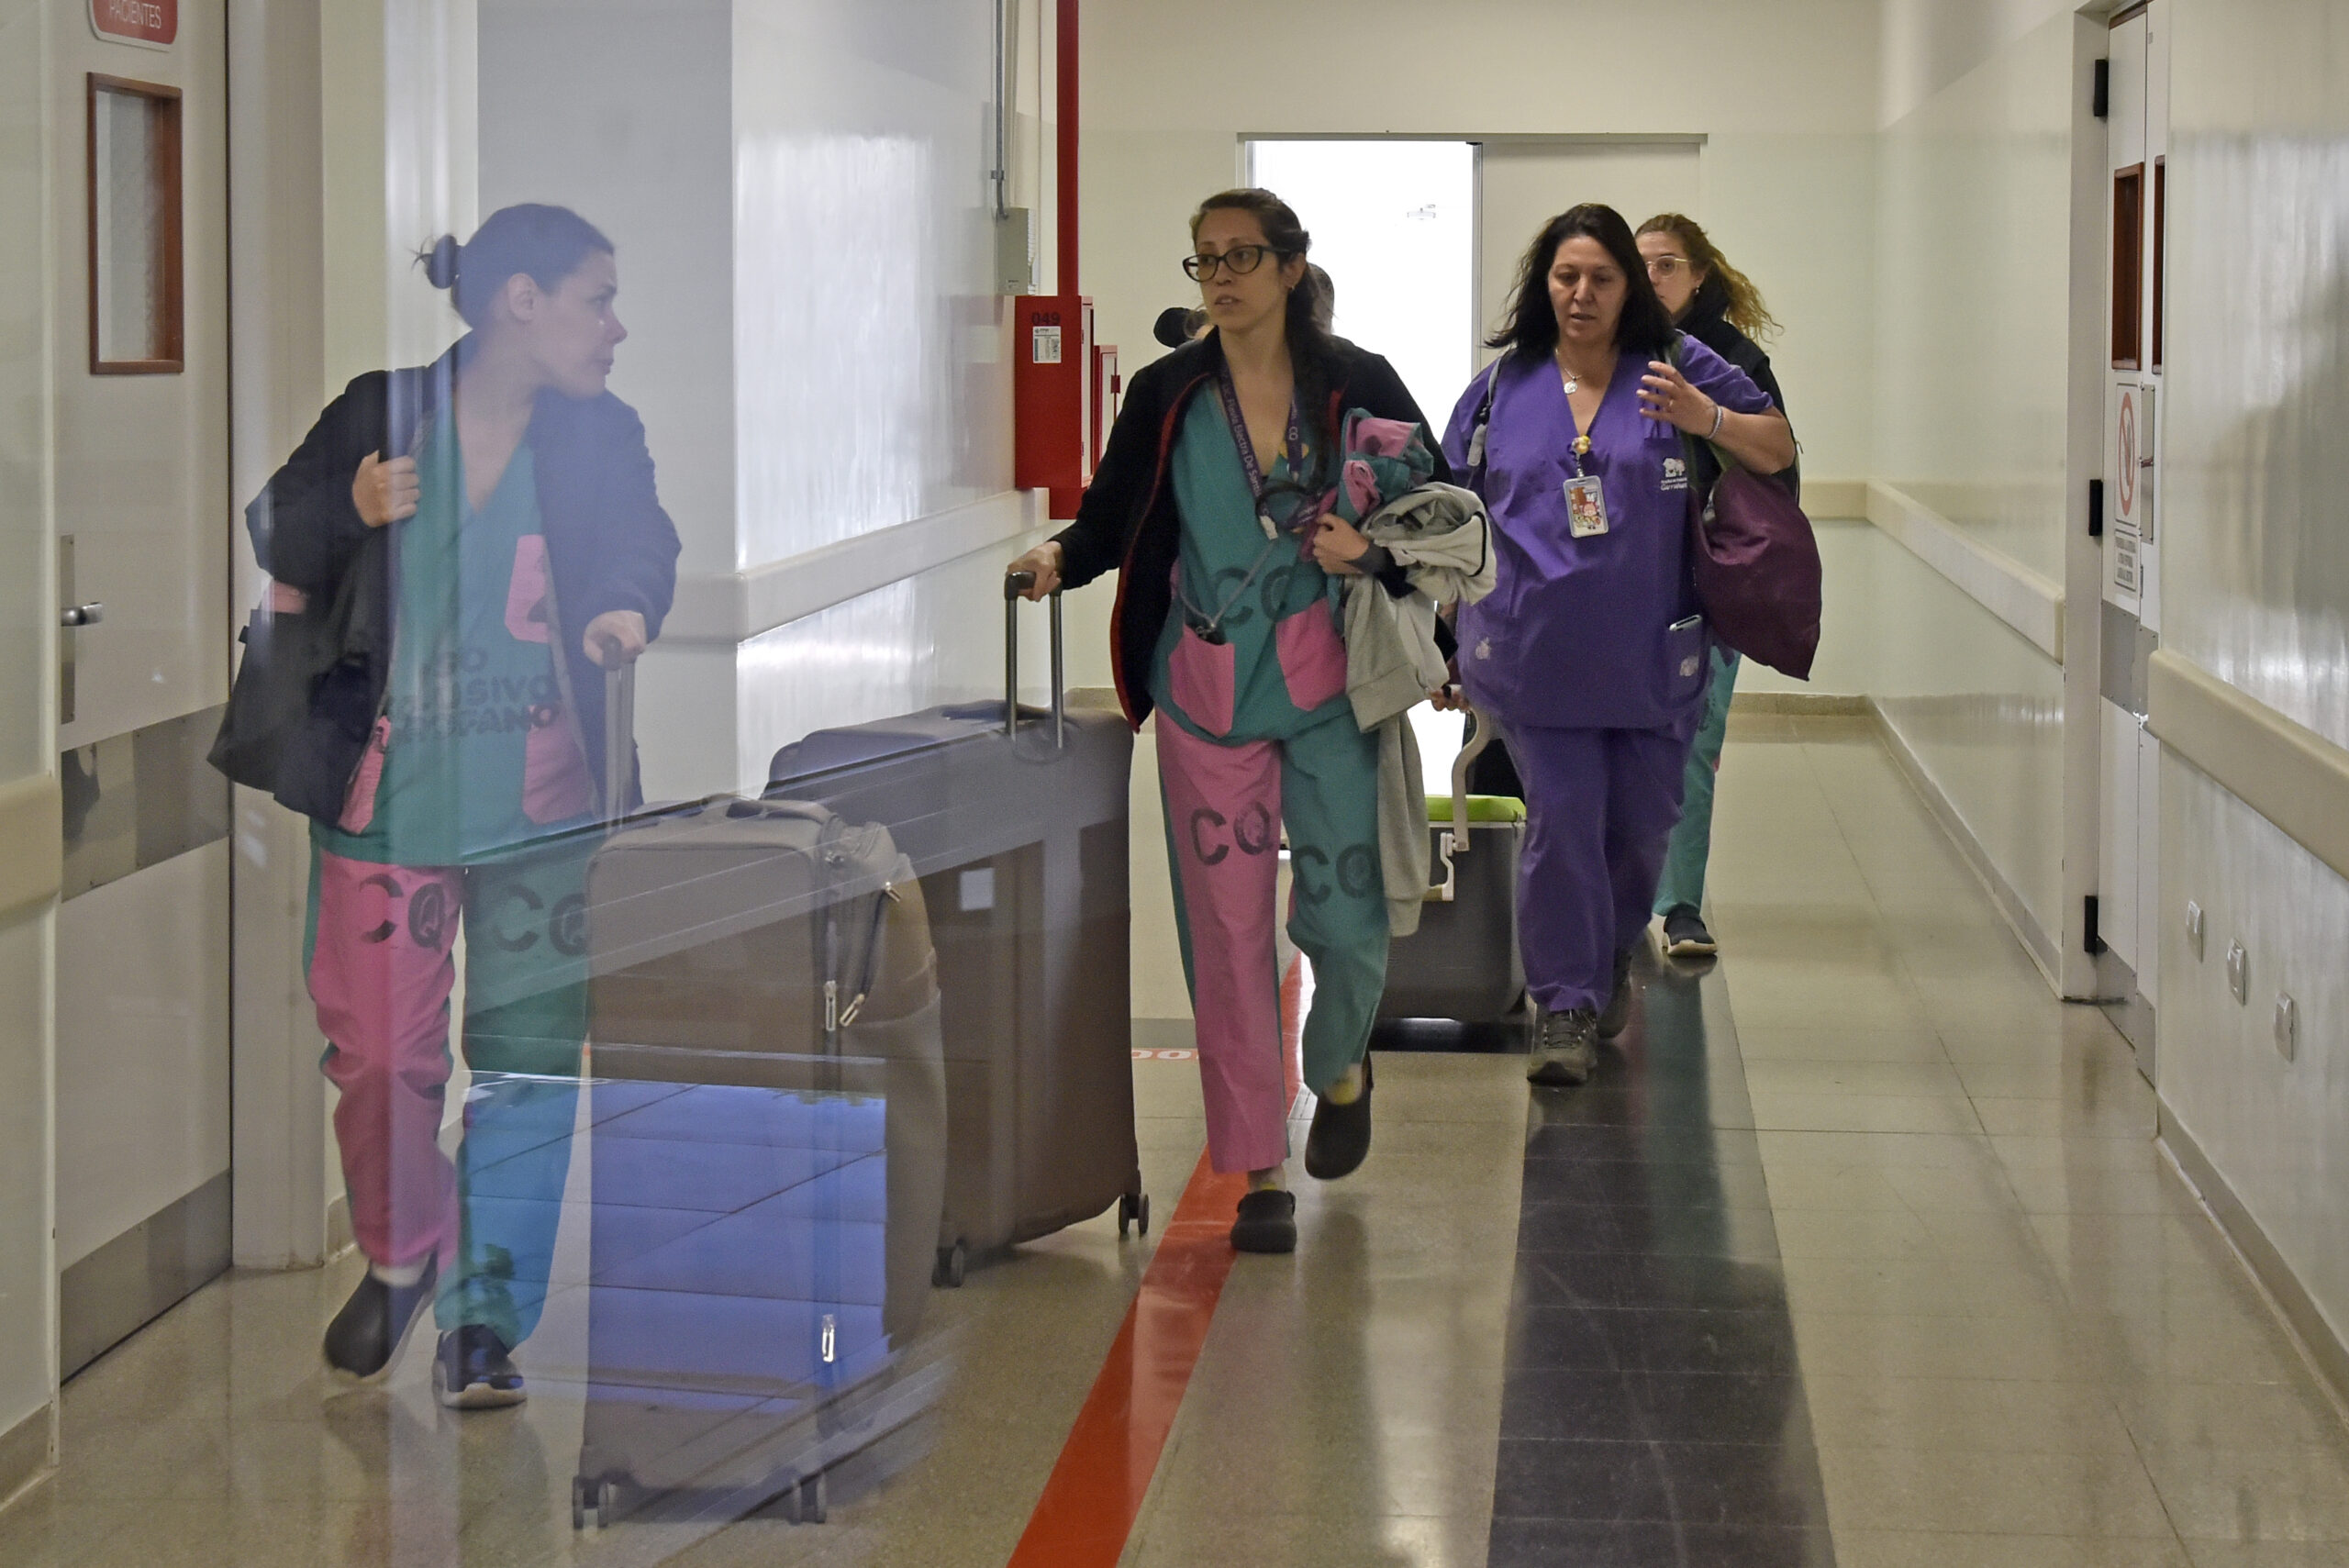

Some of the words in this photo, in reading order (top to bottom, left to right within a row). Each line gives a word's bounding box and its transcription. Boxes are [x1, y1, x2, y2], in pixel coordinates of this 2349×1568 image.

[110, 0, 162, 28] PACIENTES
[1031, 311, 1061, 324] 049
[1243, 455, 1254, 469] De
[1191, 800, 1275, 865] CQ
